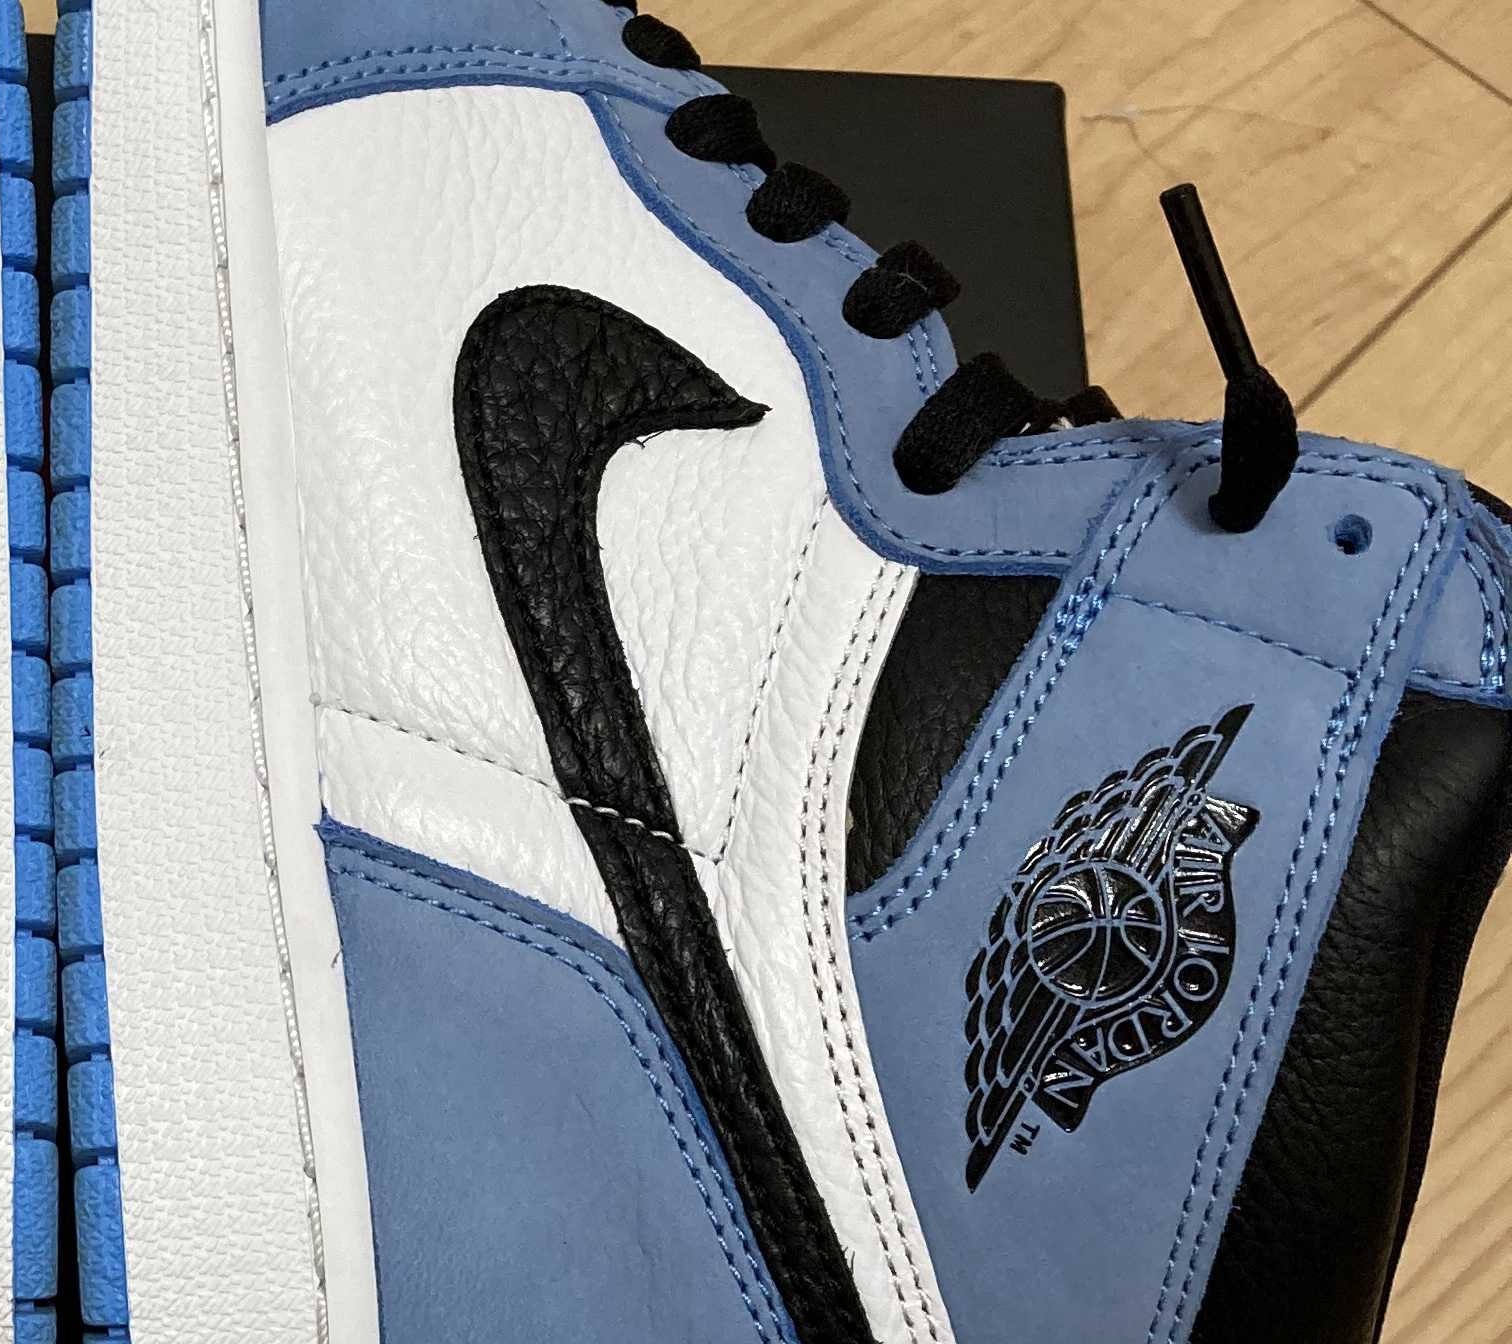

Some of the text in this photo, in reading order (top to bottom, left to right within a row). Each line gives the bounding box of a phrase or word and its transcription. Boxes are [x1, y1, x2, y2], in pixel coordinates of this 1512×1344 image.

[1044, 812, 1231, 1110] AIR JORDAN
[1009, 1122, 1041, 1156] TM
